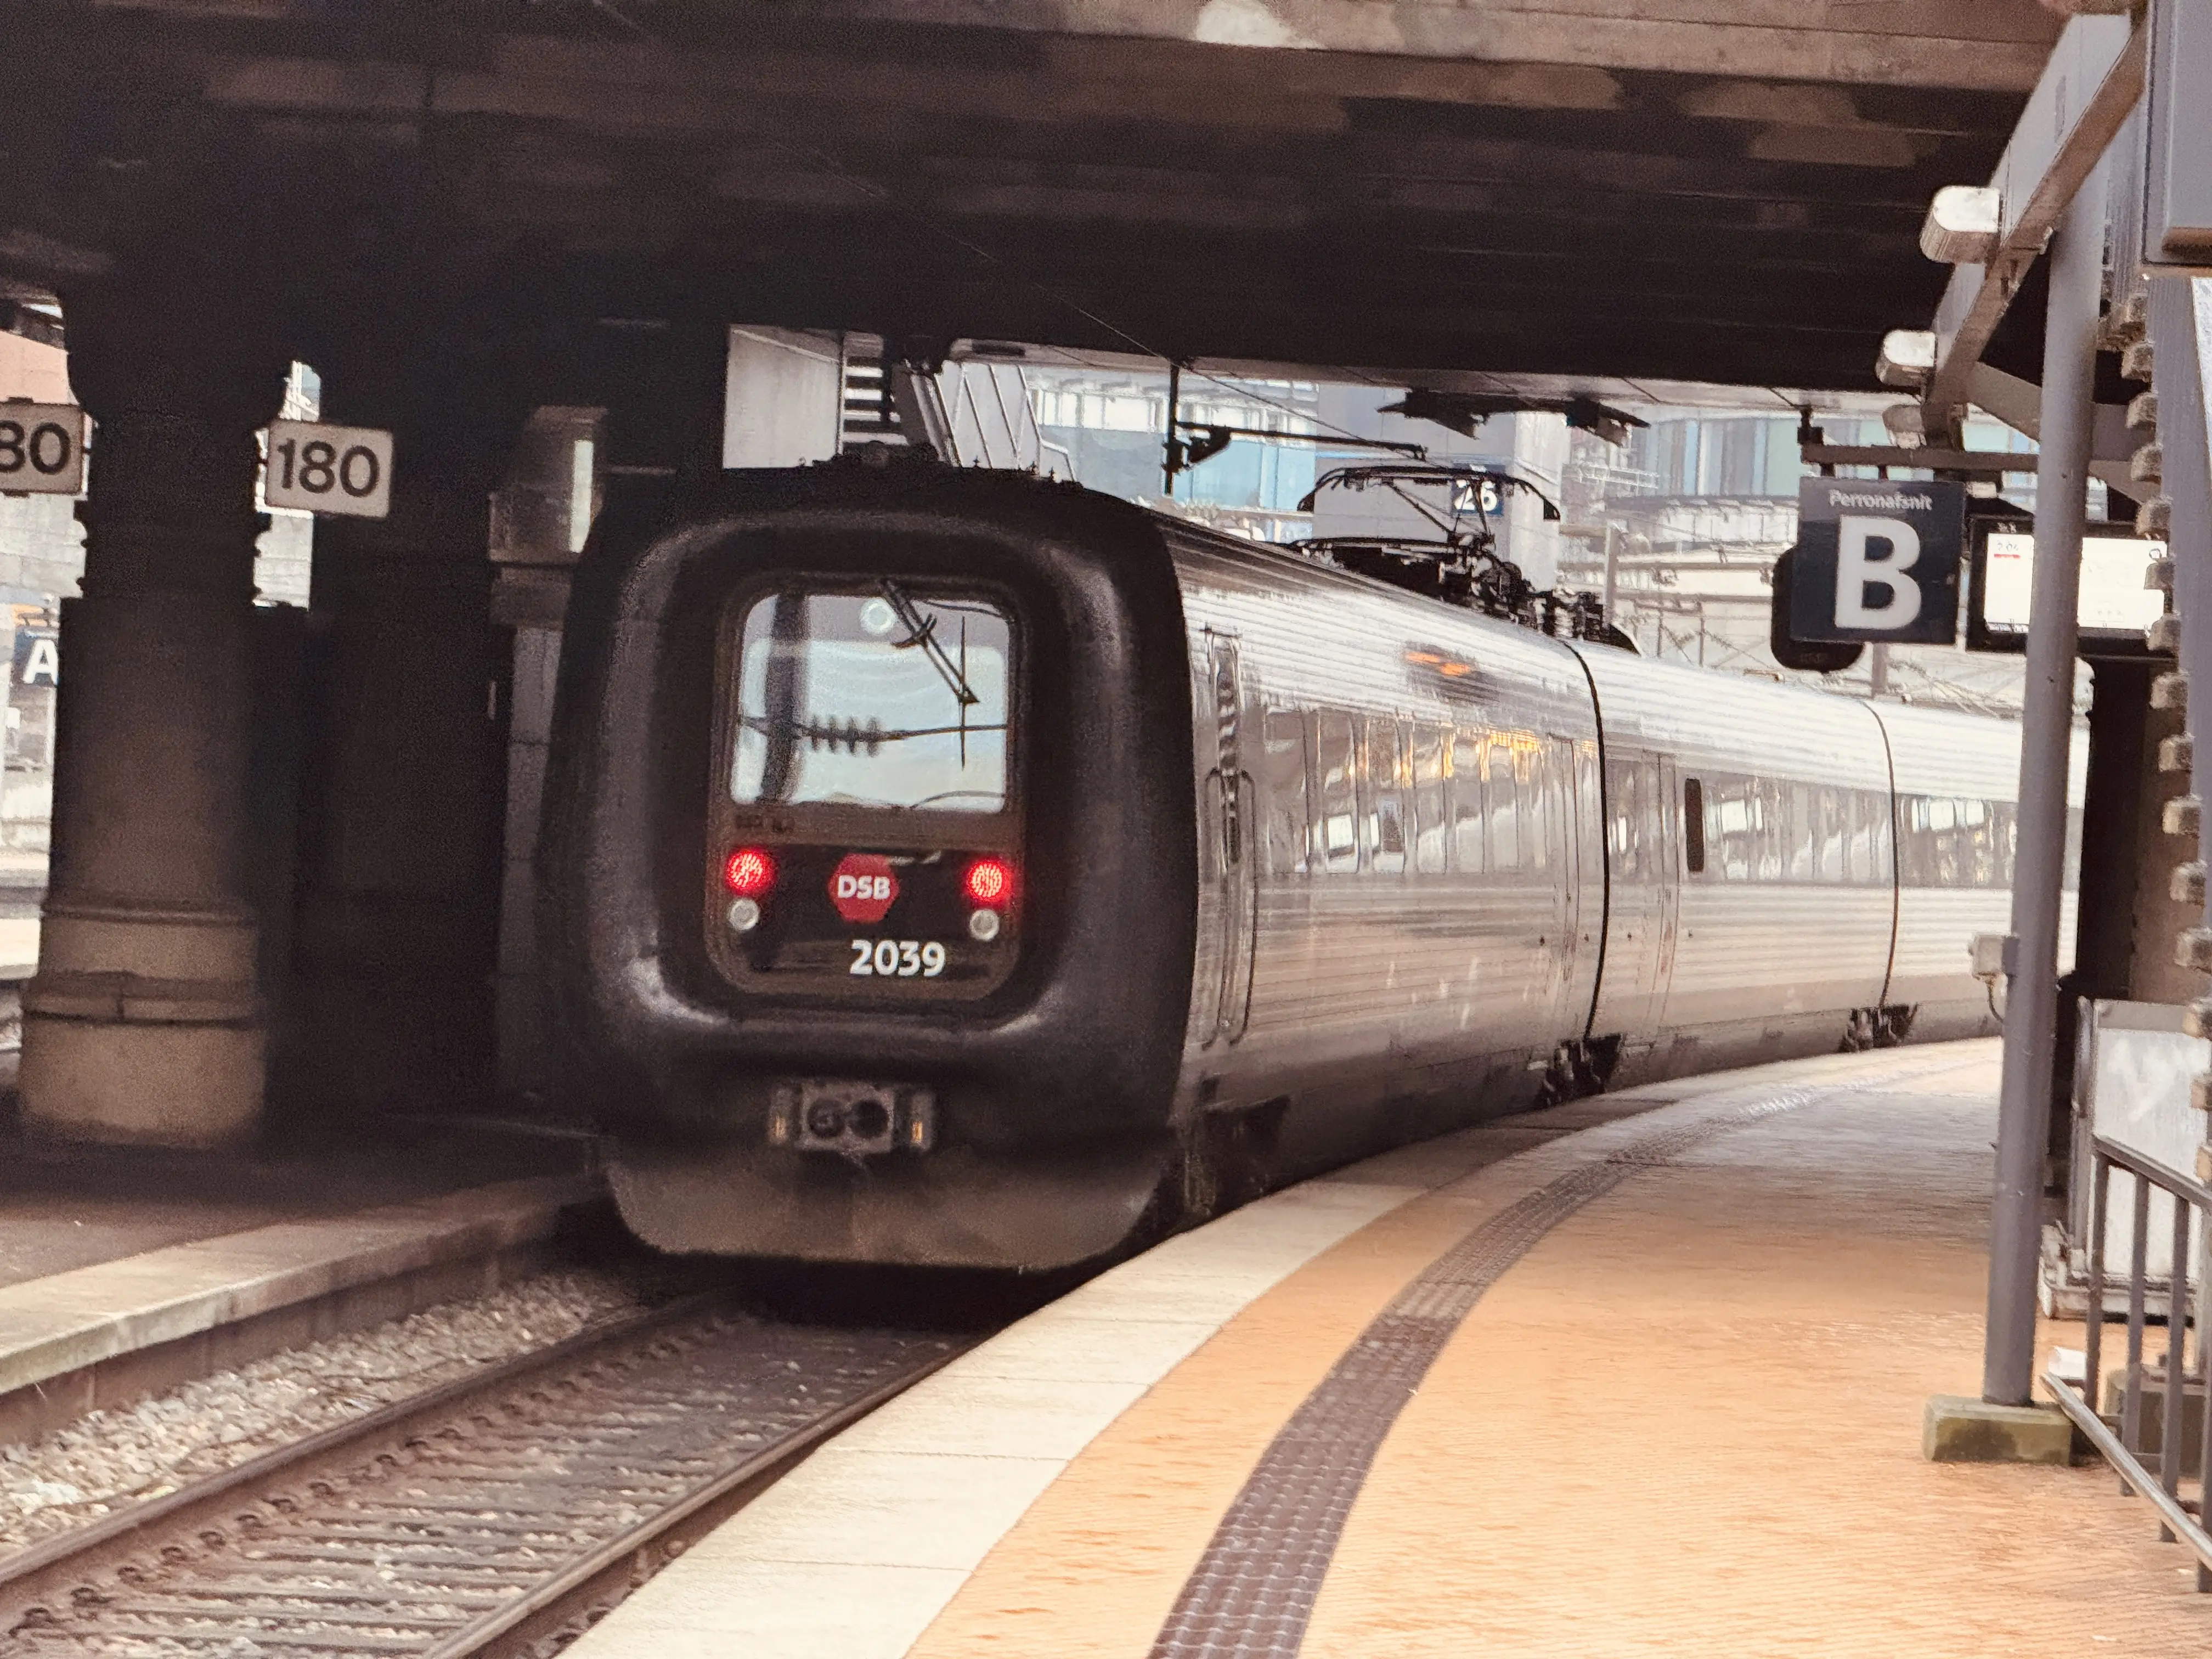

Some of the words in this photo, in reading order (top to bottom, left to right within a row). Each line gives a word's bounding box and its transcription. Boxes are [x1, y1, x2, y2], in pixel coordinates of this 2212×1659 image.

[277, 438, 380, 498] 180
[1454, 479, 1498, 511] 26
[1835, 515, 1922, 629] B
[23, 639, 59, 685] A
[838, 874, 890, 900] DSB
[850, 939, 946, 977] 2039
